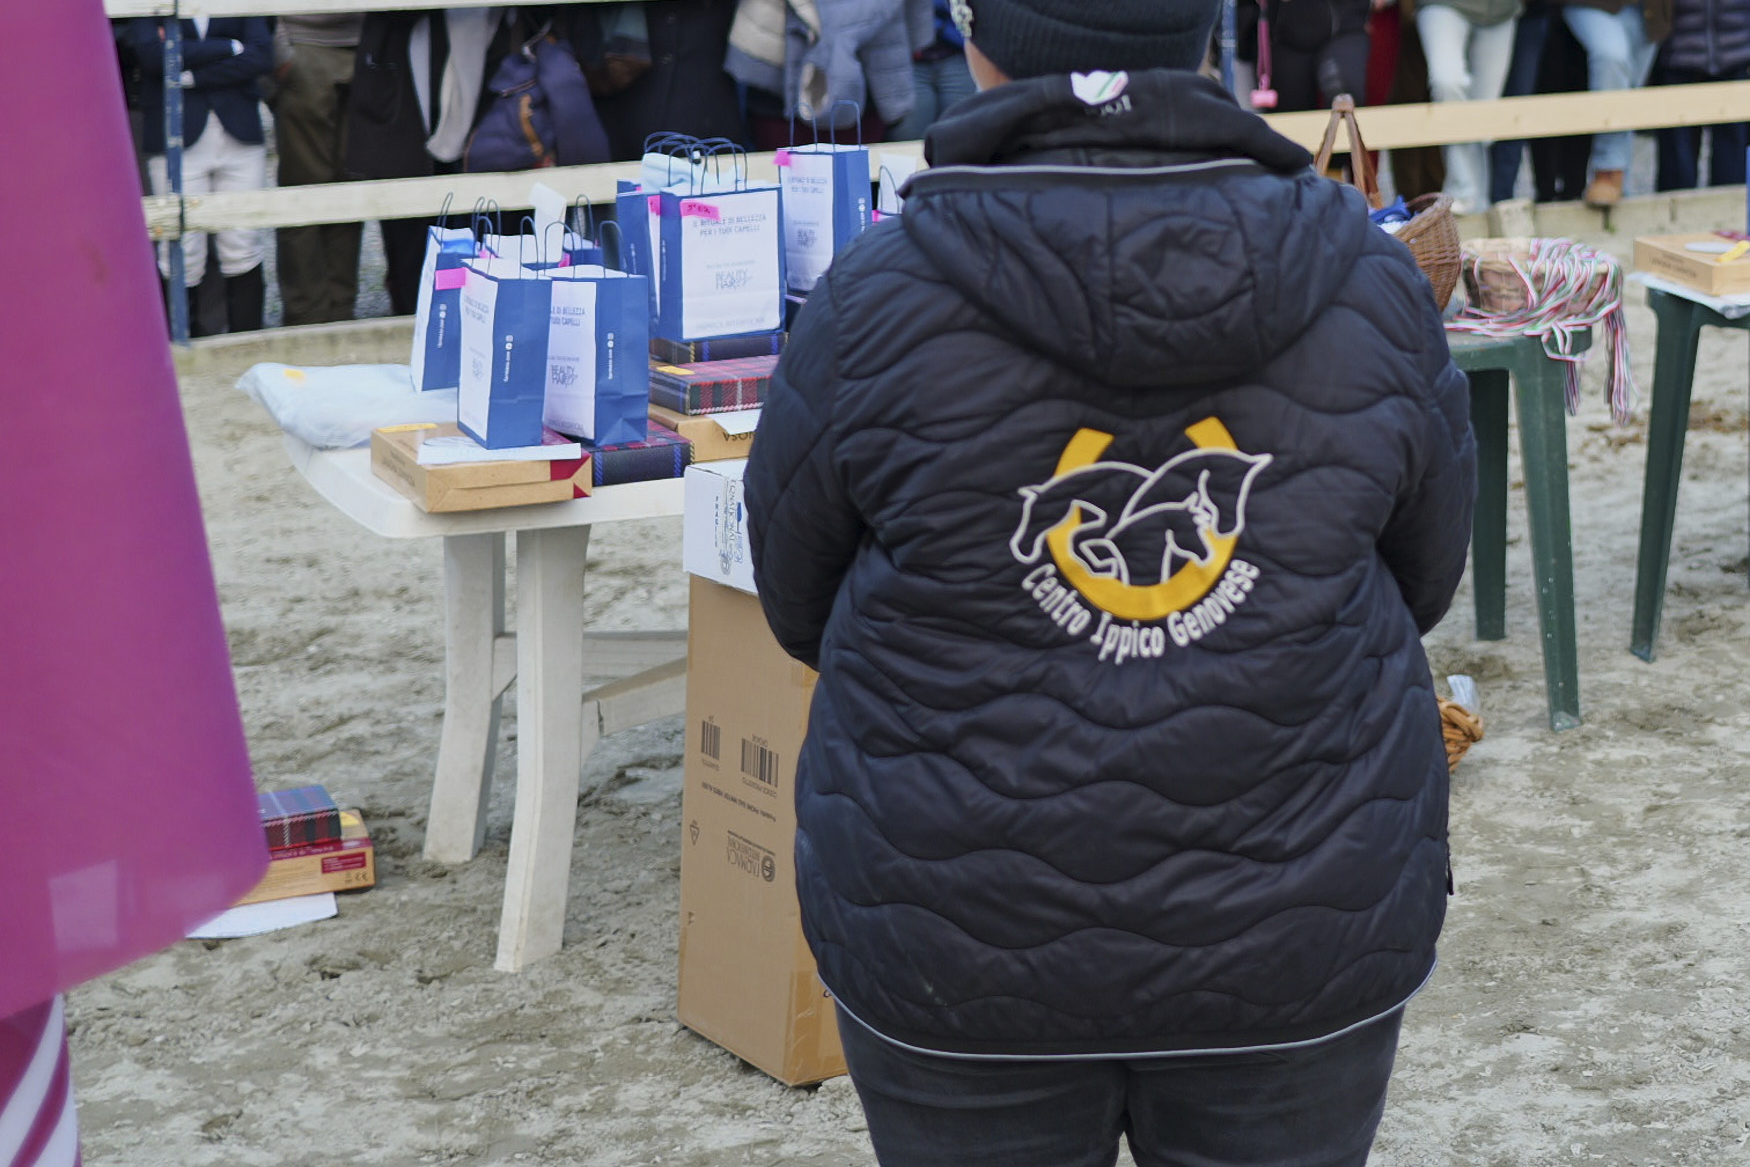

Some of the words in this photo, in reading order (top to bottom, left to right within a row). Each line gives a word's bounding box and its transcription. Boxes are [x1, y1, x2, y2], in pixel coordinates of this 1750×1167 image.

[1021, 562, 1092, 635] Centro
[1090, 611, 1165, 665] Ippico
[1167, 557, 1261, 647] Genovese
